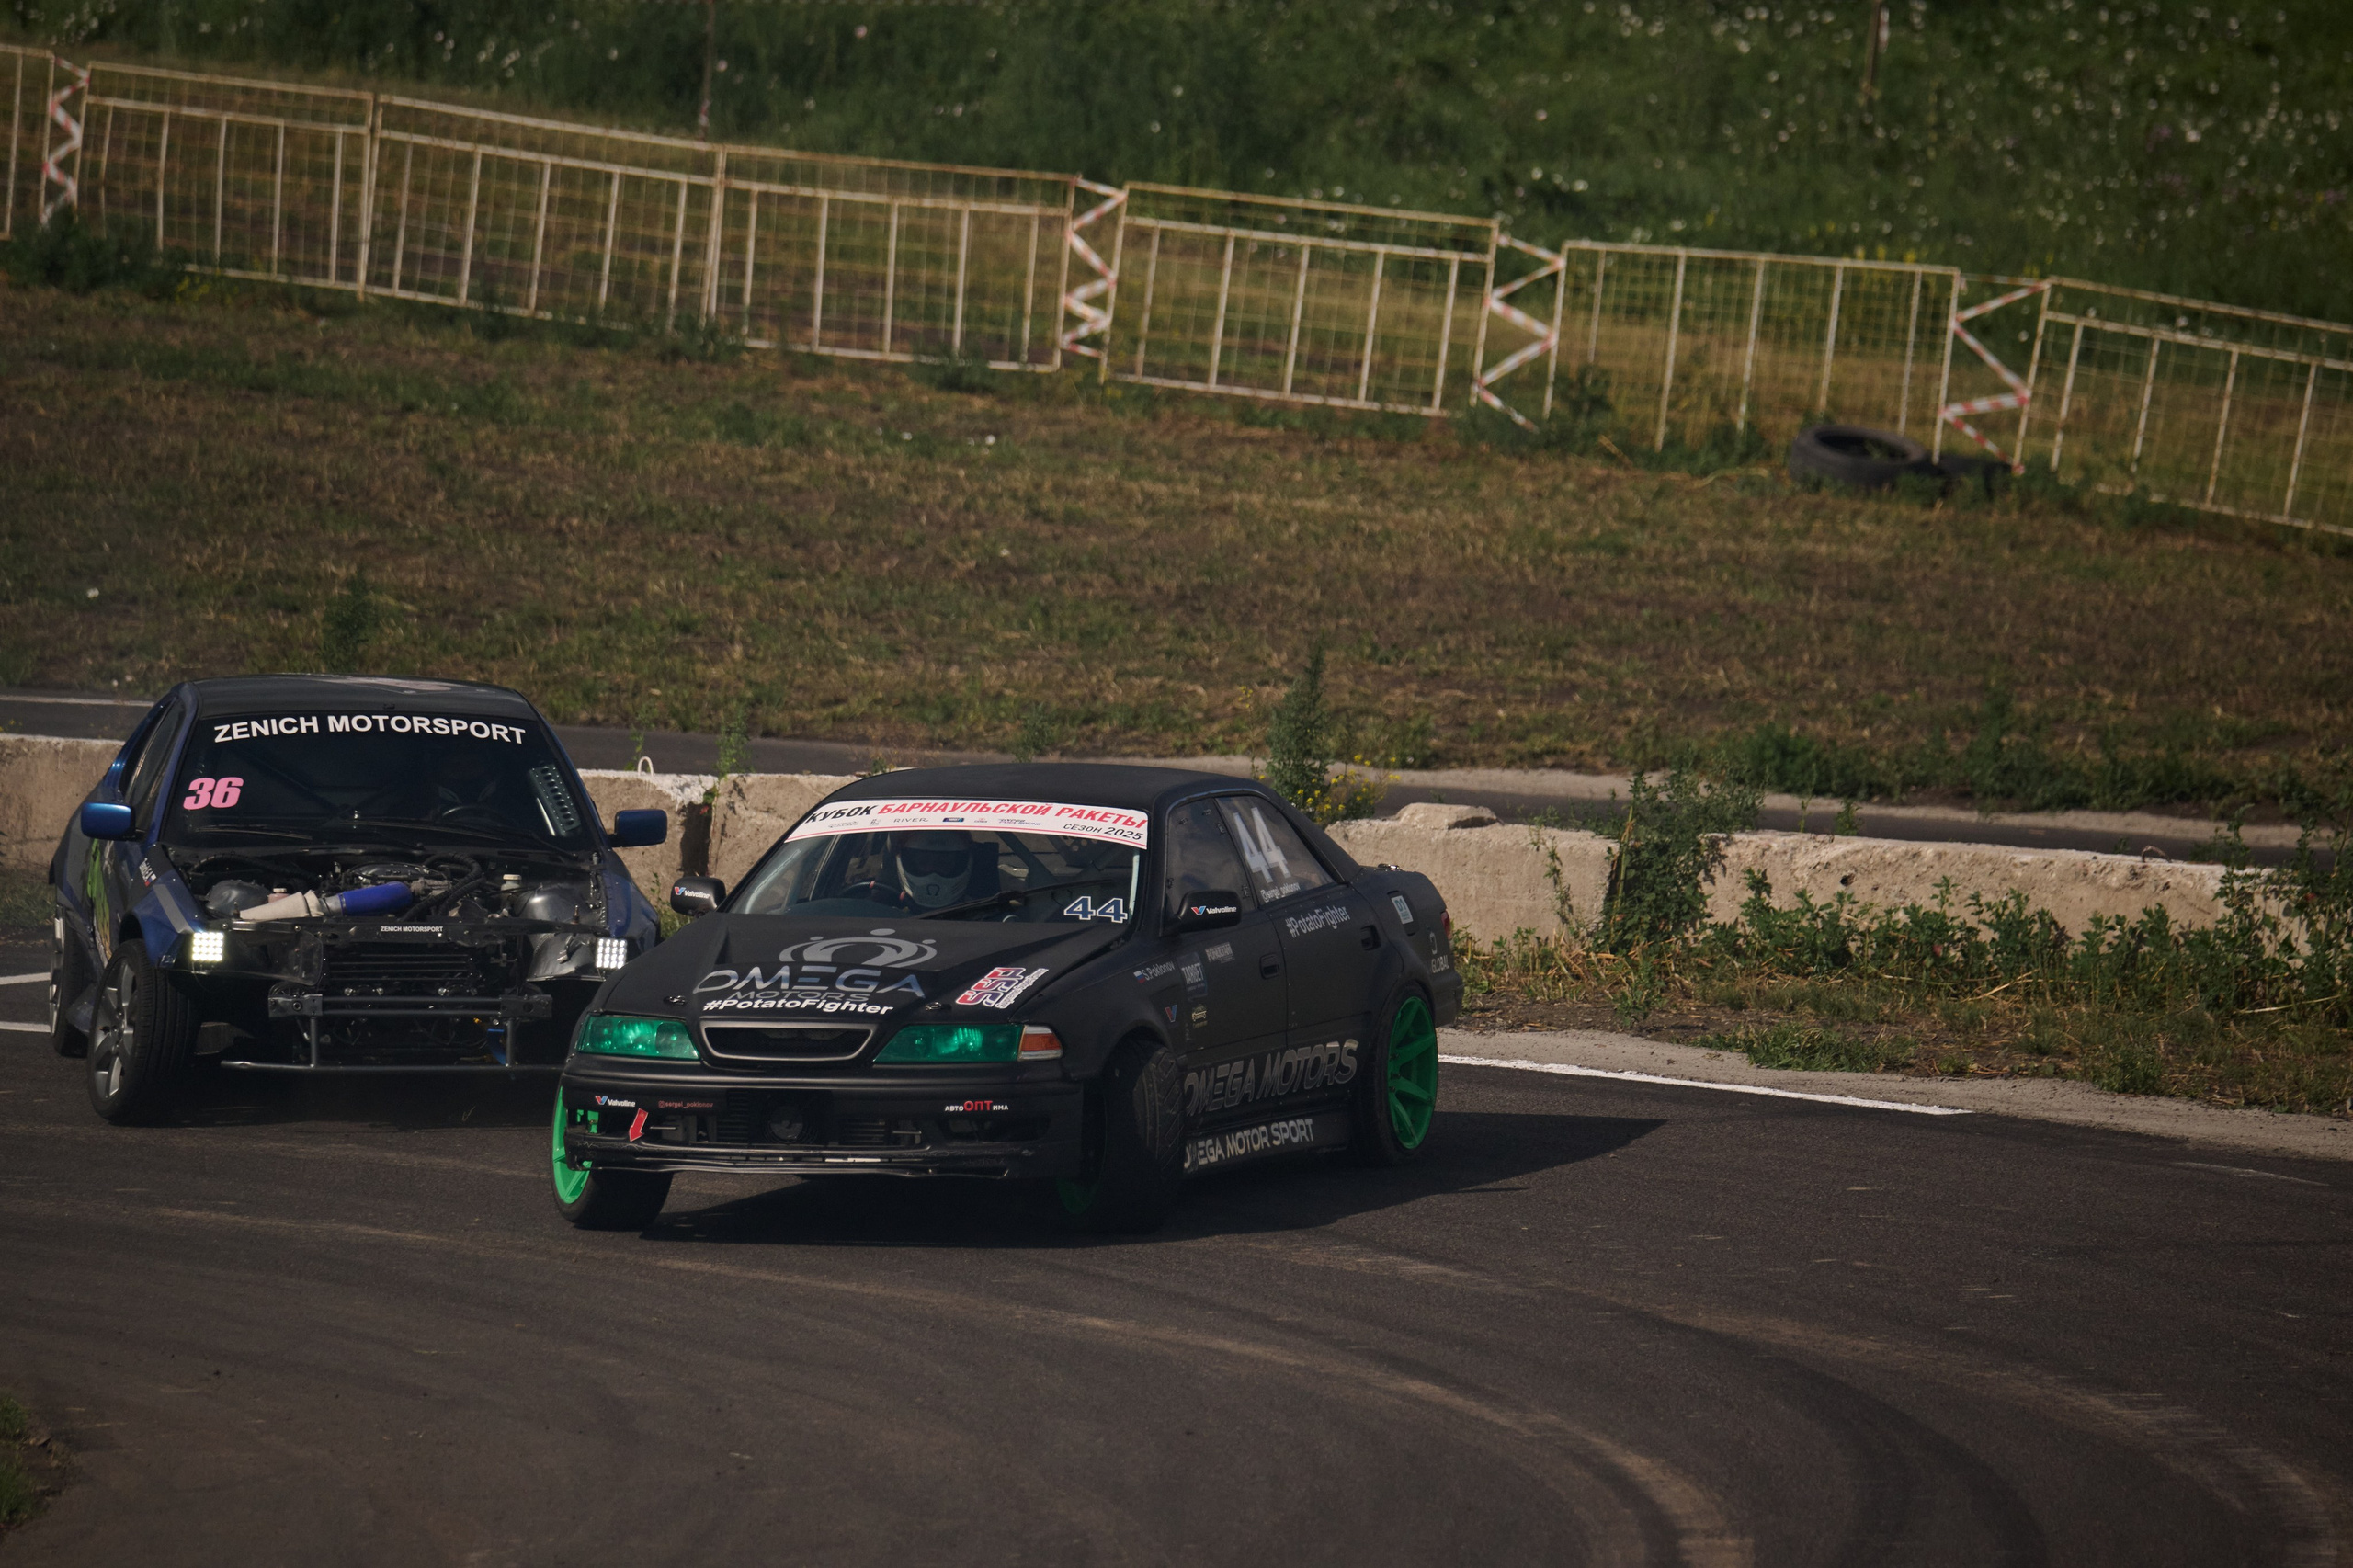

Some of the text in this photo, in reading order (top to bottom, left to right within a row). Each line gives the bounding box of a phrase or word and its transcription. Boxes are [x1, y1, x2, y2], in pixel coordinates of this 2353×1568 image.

[214, 715, 526, 744] ZENICH MOTORSPORT
[183, 777, 244, 811] 36
[804, 805, 878, 824] КУБОК
[878, 802, 1053, 816] БАРНАУЛЬСКОЙ
[1055, 807, 1148, 829] РАКЕТЫ
[1063, 824, 1144, 840] СЕЗОН 2025
[1233, 807, 1292, 883] 44
[684, 890, 710, 899] Valvoline
[1063, 895, 1128, 924] 44
[1206, 906, 1237, 915] Valvoline
[1285, 905, 1351, 938] #PotatoFighter
[693, 965, 926, 999] OMEGA
[1142, 961, 1176, 982] S.Poklonov
[702, 998, 894, 1015] #PotatoFighter
[726, 990, 871, 1002] MOTORS
[1256, 1039, 1359, 1100] MOTORS
[607, 1098, 636, 1108] Valvoline
[1225, 1125, 1271, 1159] MOTOR
[1270, 1118, 1314, 1146] SPORT
